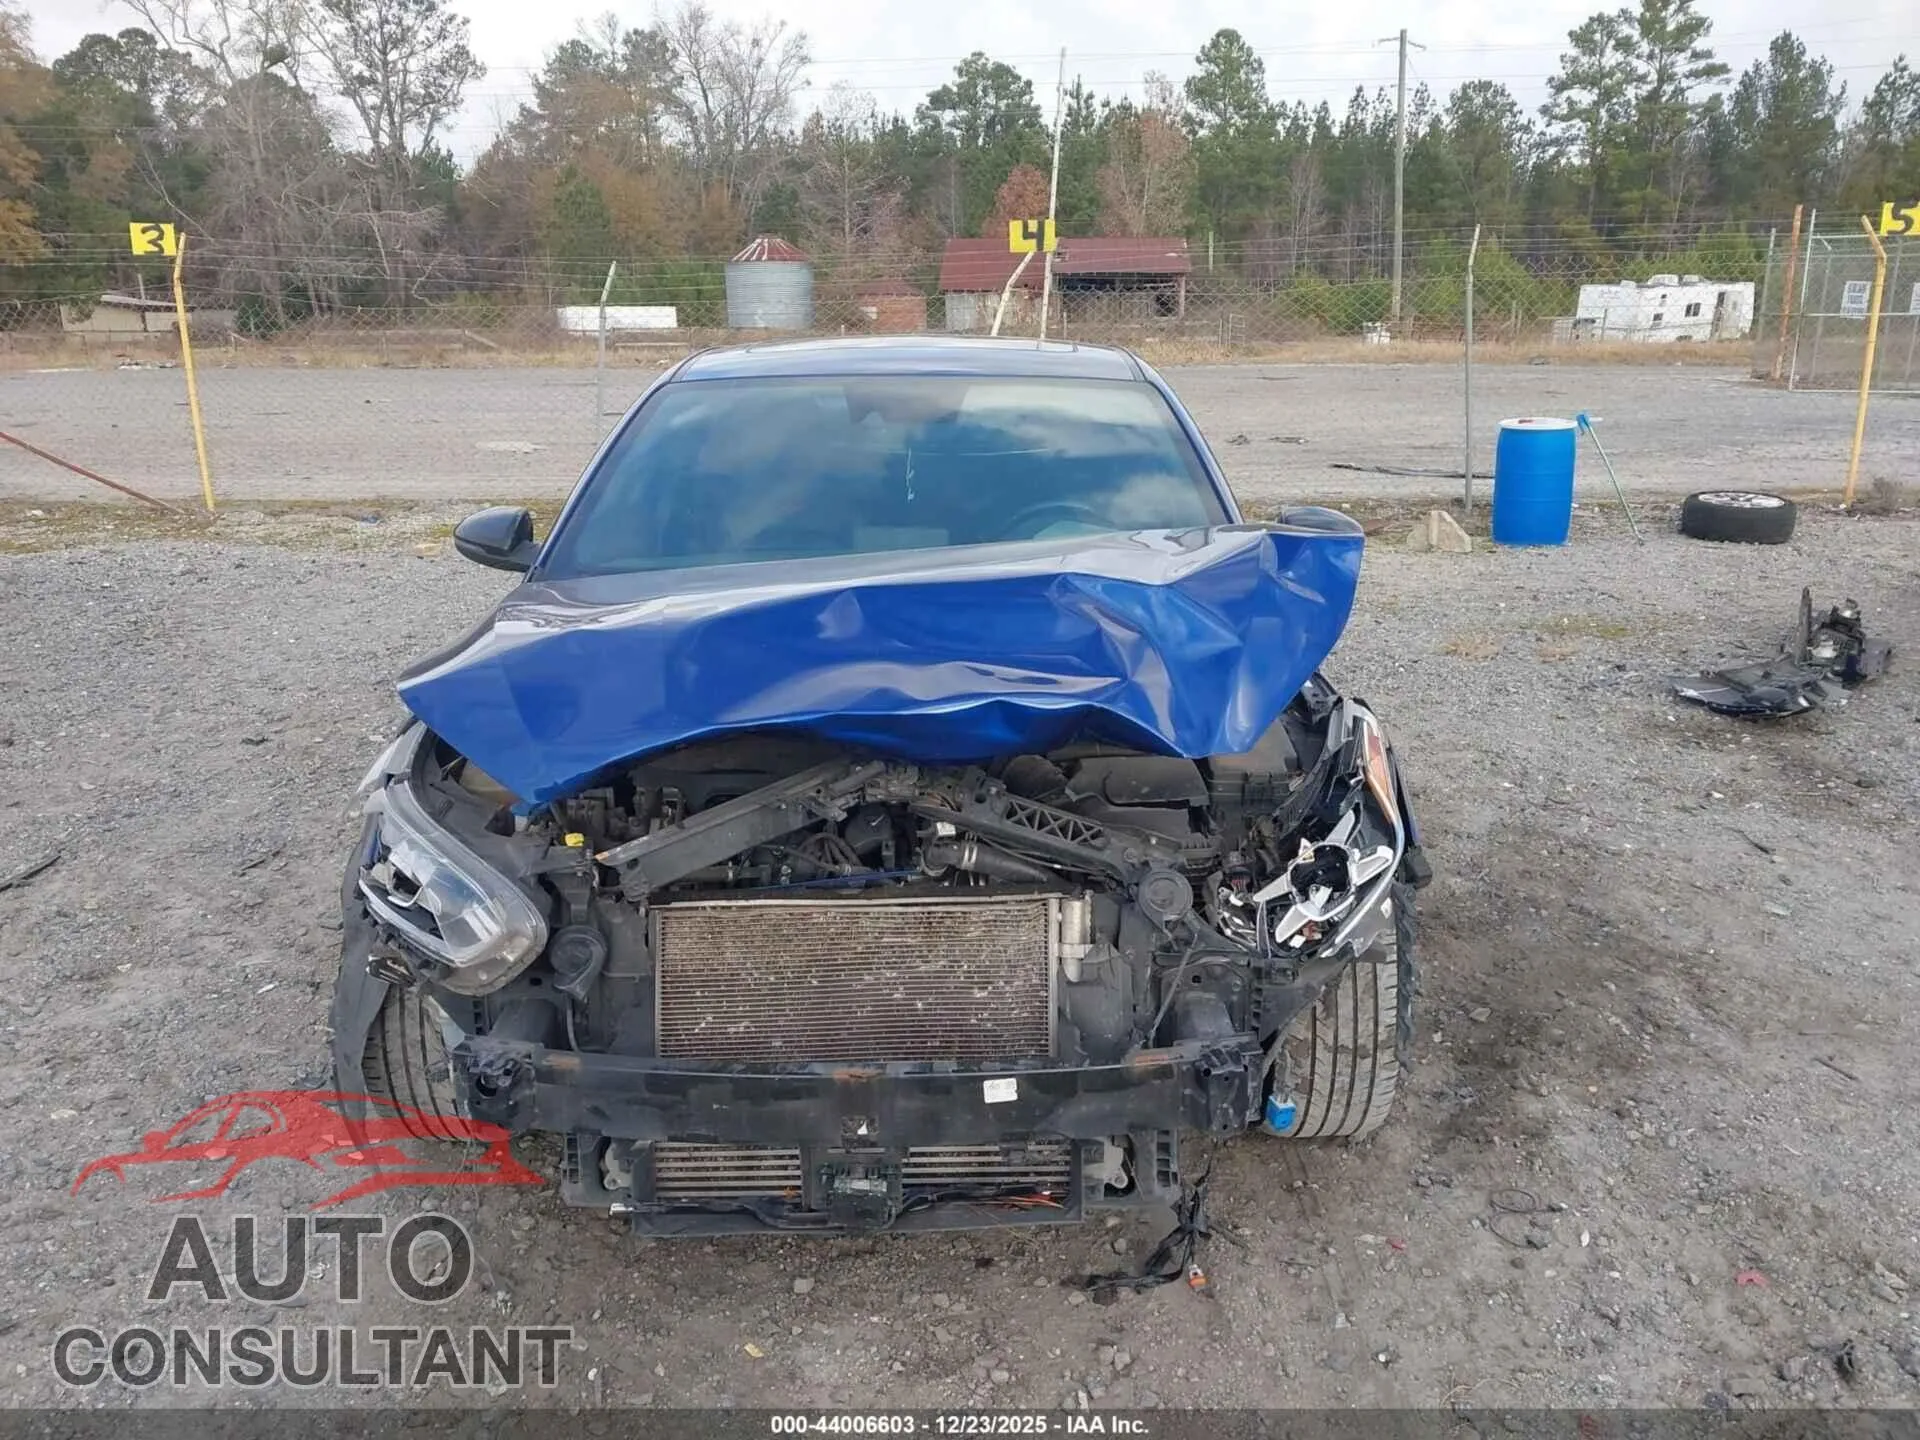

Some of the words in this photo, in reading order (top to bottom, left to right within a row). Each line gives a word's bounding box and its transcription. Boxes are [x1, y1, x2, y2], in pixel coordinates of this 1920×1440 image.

[1887, 202, 1917, 235] 5
[140, 223, 165, 254] 3
[1022, 219, 1045, 251] 4
